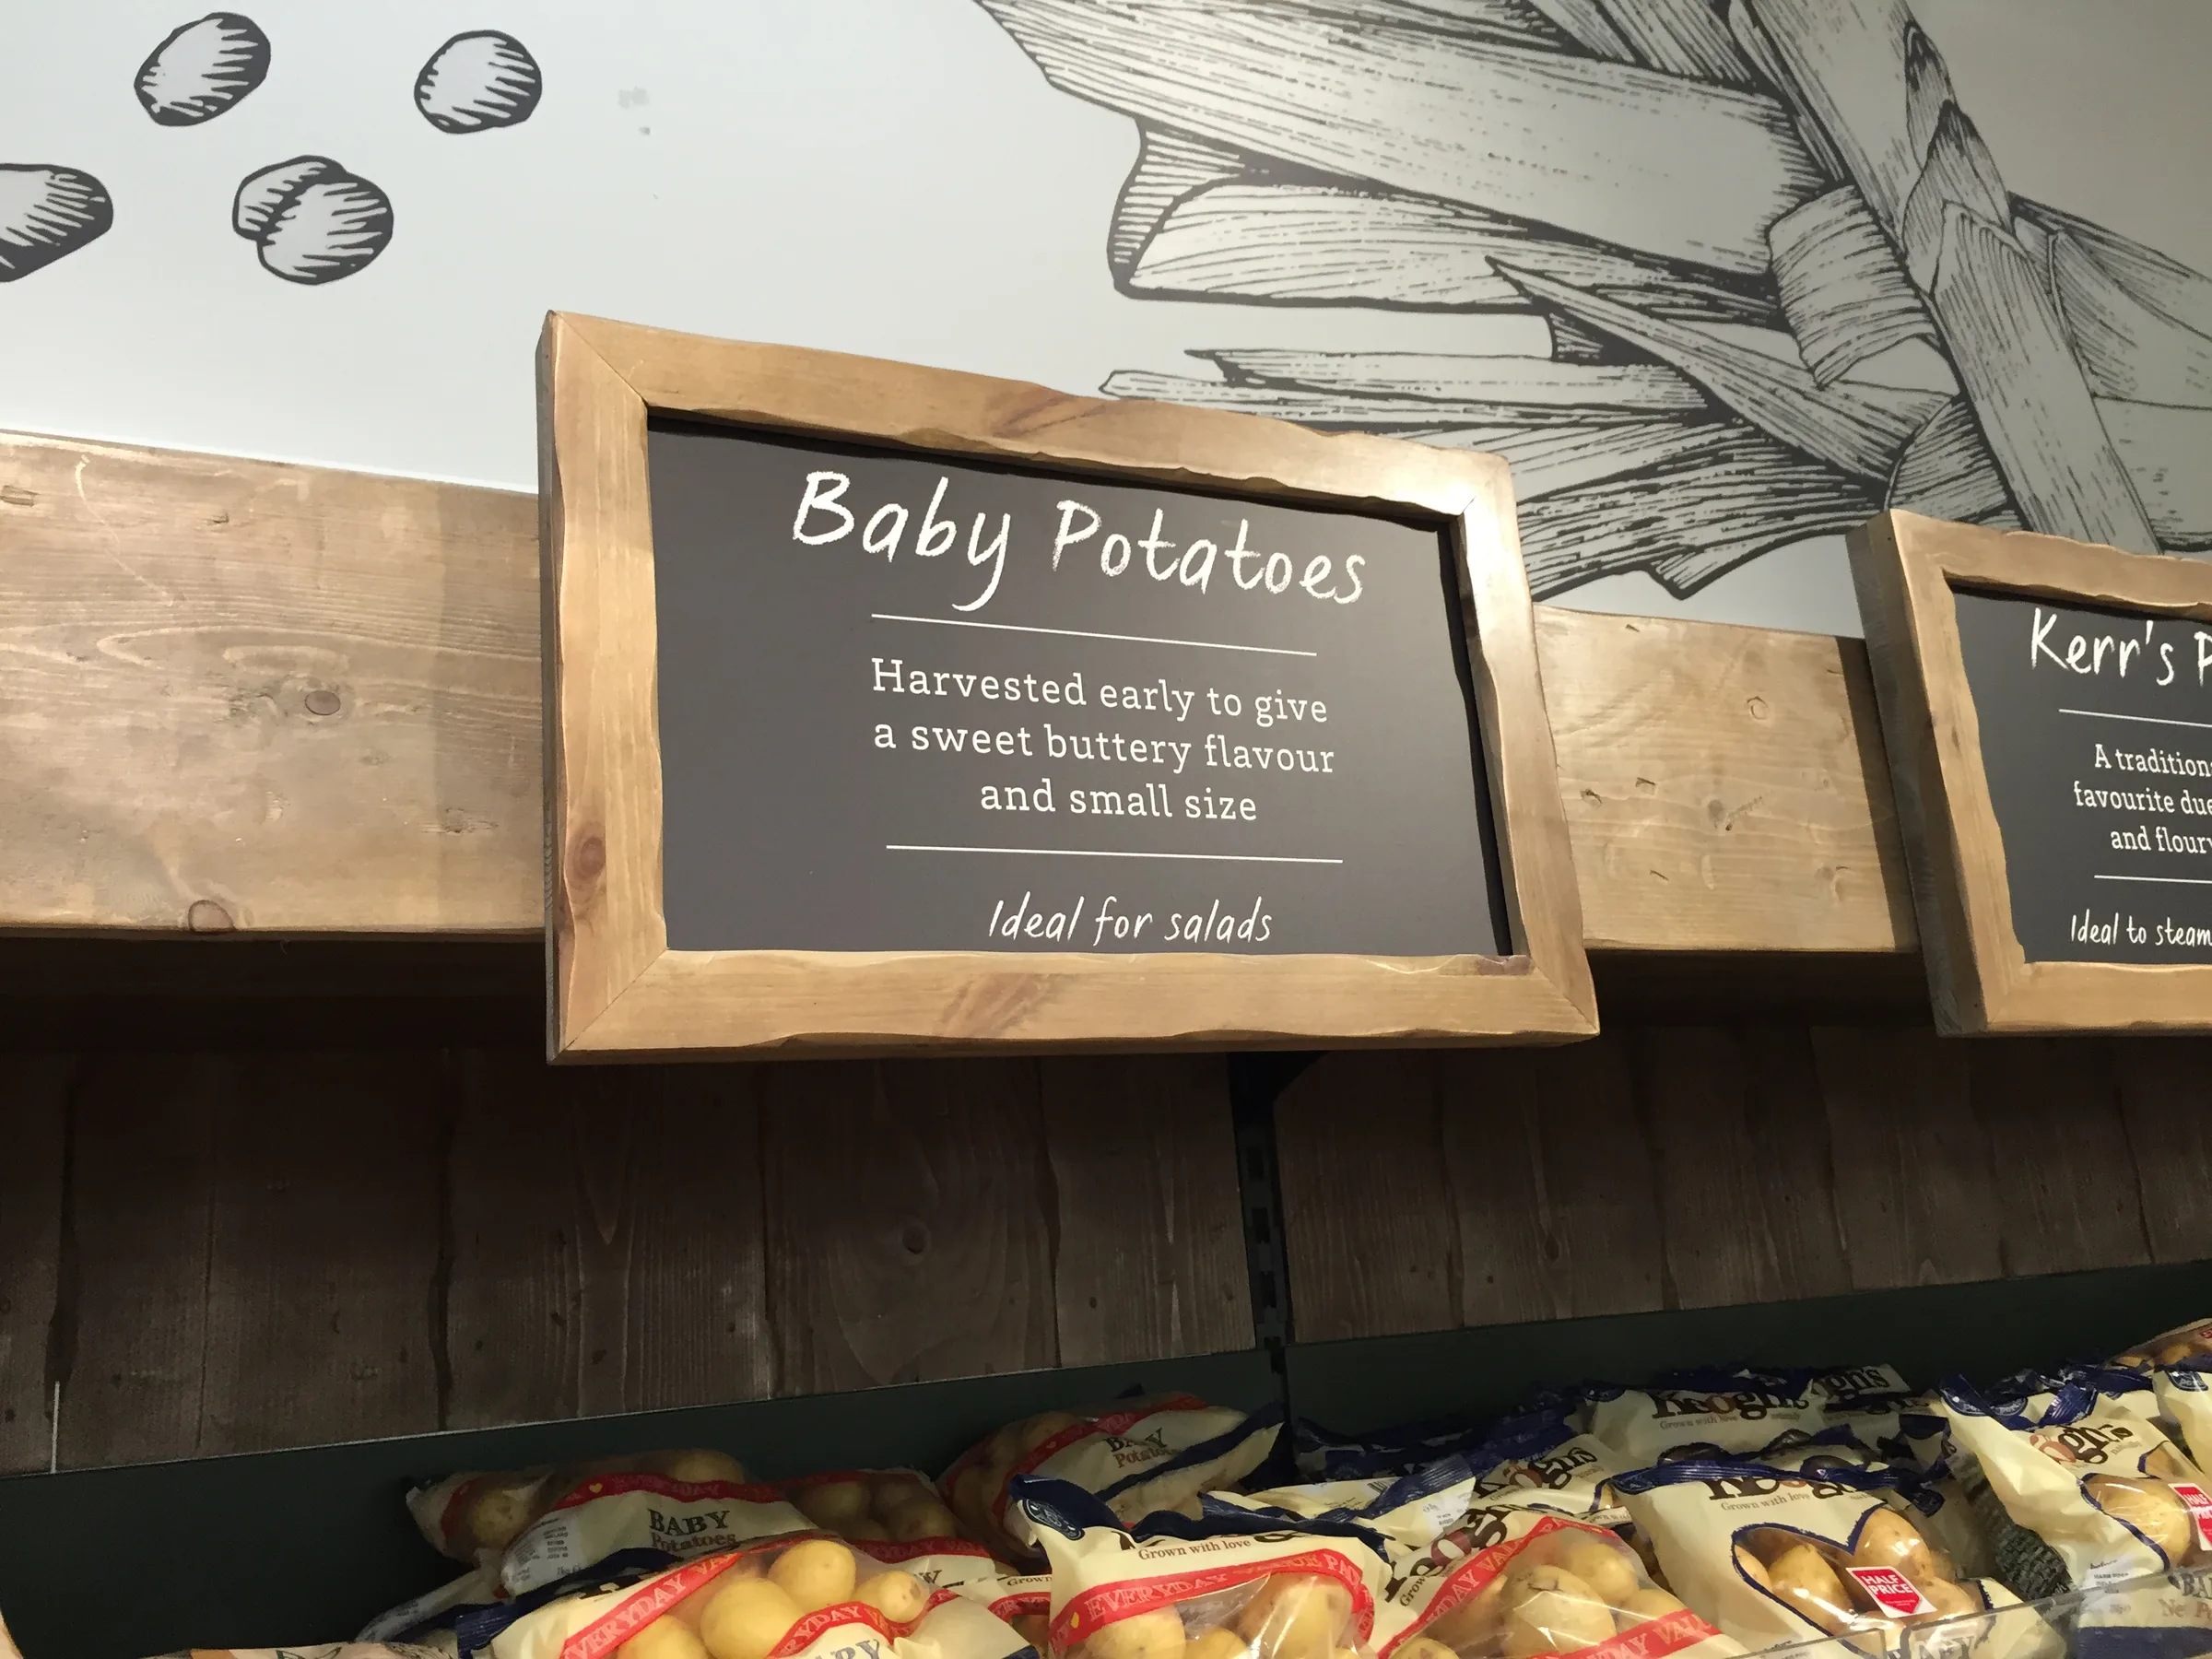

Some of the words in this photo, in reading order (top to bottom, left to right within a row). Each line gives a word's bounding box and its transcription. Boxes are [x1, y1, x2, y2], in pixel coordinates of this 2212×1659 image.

[793, 471, 1010, 611] Baby
[1053, 500, 1366, 605] Potatoes
[2031, 607, 2174, 686] Kerr's
[872, 658, 1087, 706] Harvested
[1100, 679, 1195, 722] early
[1207, 688, 1242, 716] to
[1255, 688, 1327, 728] give
[875, 724, 897, 748] a
[912, 727, 1033, 757] sweet
[1044, 724, 1192, 774] buttery
[1205, 735, 1335, 773] flavour
[2095, 743, 2112, 769] A
[2115, 747, 2212, 778] tradition
[981, 778, 1055, 812] and
[1070, 783, 1173, 818] small
[1185, 787, 1257, 821] size
[2074, 781, 2174, 813] favourite
[2111, 825, 2151, 851] and
[989, 890, 1085, 941] Ideal
[1093, 896, 1153, 947] for
[1164, 897, 1272, 943] salads
[2071, 909, 2119, 946] Ideal
[2126, 915, 2147, 945] to
[1721, 1500, 1759, 1512] Grown
[1761, 1495, 1787, 1507] with
[647, 1509, 730, 1536] BABY
[1137, 1547, 1186, 1560] Grown
[1189, 1542, 1220, 1555] with
[1223, 1537, 1252, 1550] love
[1084, 1573, 1229, 1620] EVERYDAY
[1861, 1574, 1899, 1584] HALF
[1867, 1583, 1913, 1595] PRICE
